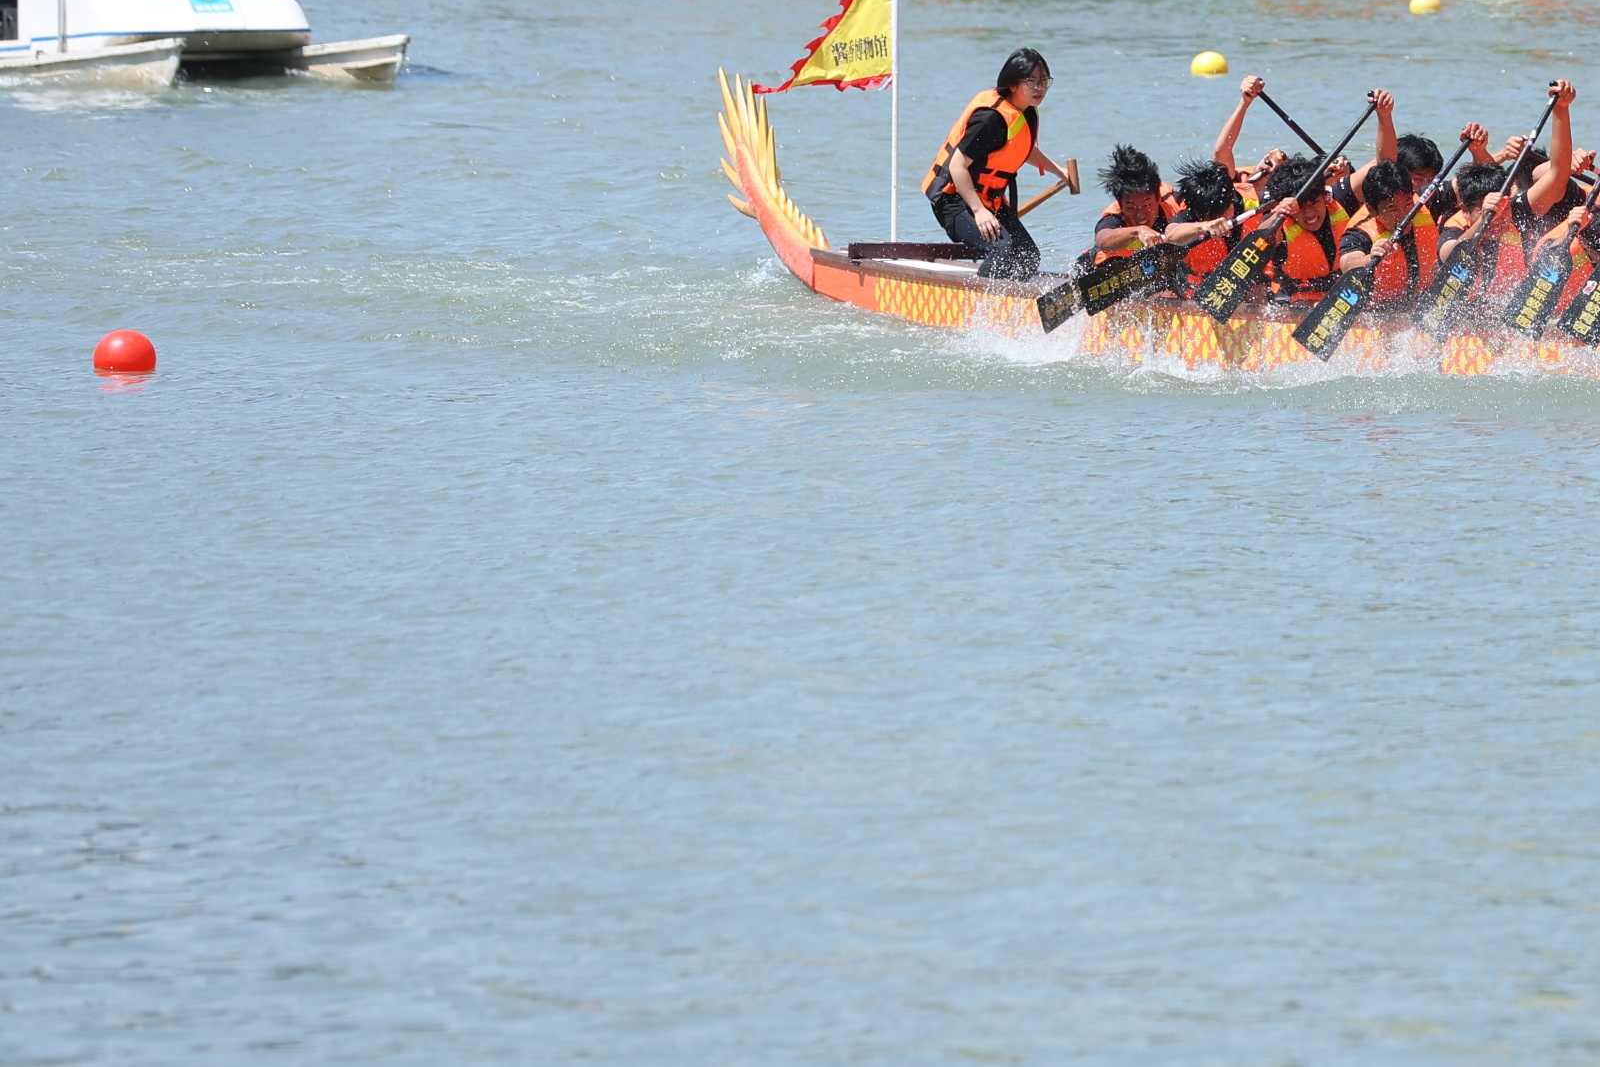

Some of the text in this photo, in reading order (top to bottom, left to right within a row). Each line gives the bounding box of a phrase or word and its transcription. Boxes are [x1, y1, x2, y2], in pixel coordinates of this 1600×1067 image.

[831, 34, 888, 67] 酱香博物馆
